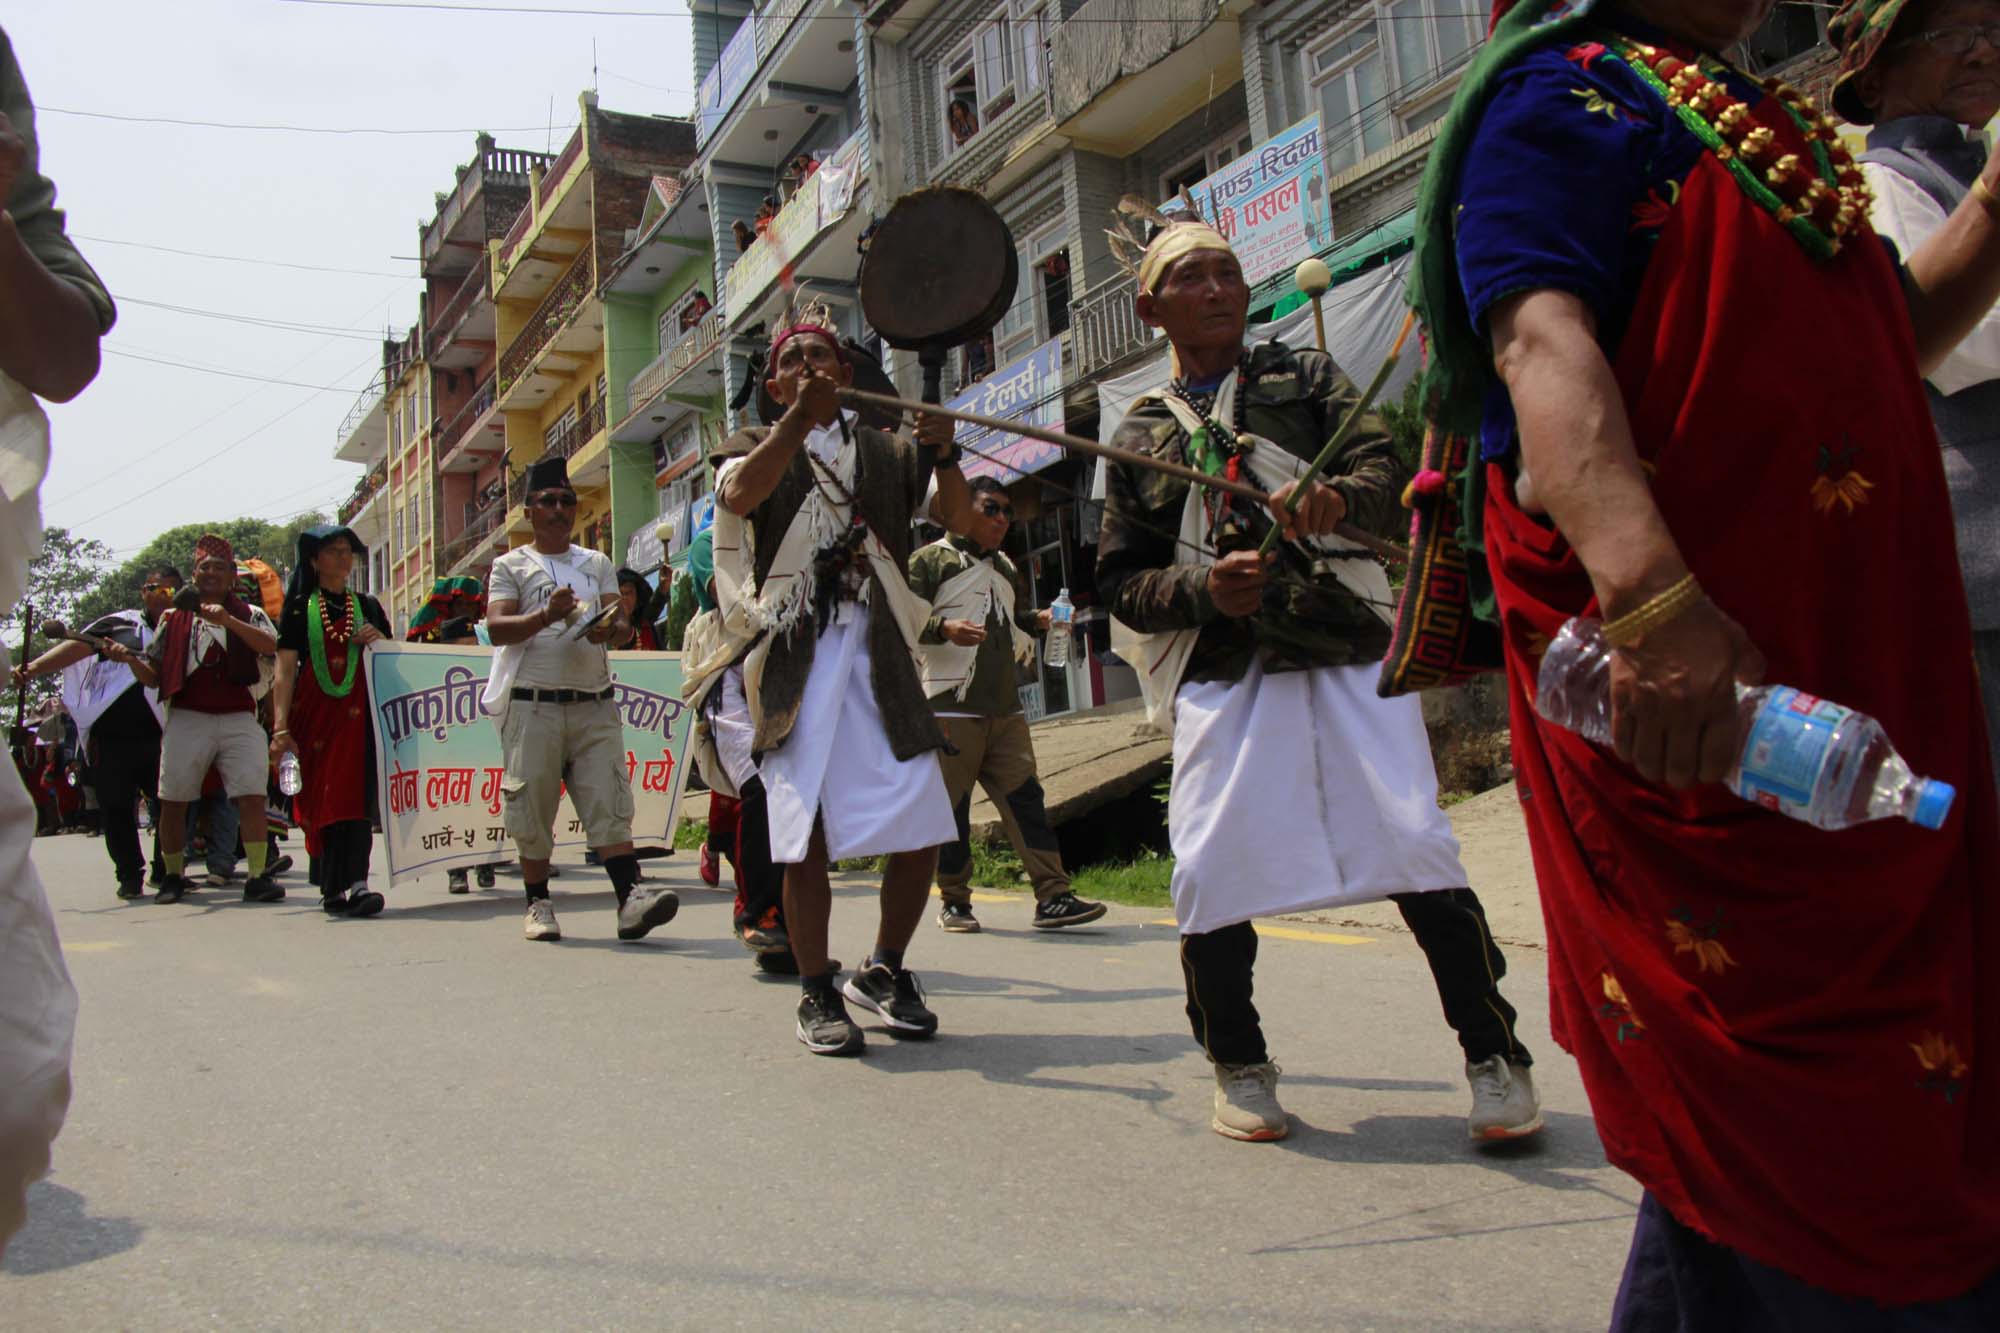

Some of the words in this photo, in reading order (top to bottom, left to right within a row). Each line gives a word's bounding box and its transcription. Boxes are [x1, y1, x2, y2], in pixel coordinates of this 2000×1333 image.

[1243, 175, 1300, 229] पसल
[983, 358, 1036, 417] टेलर्स
[425, 768, 476, 809] लम
